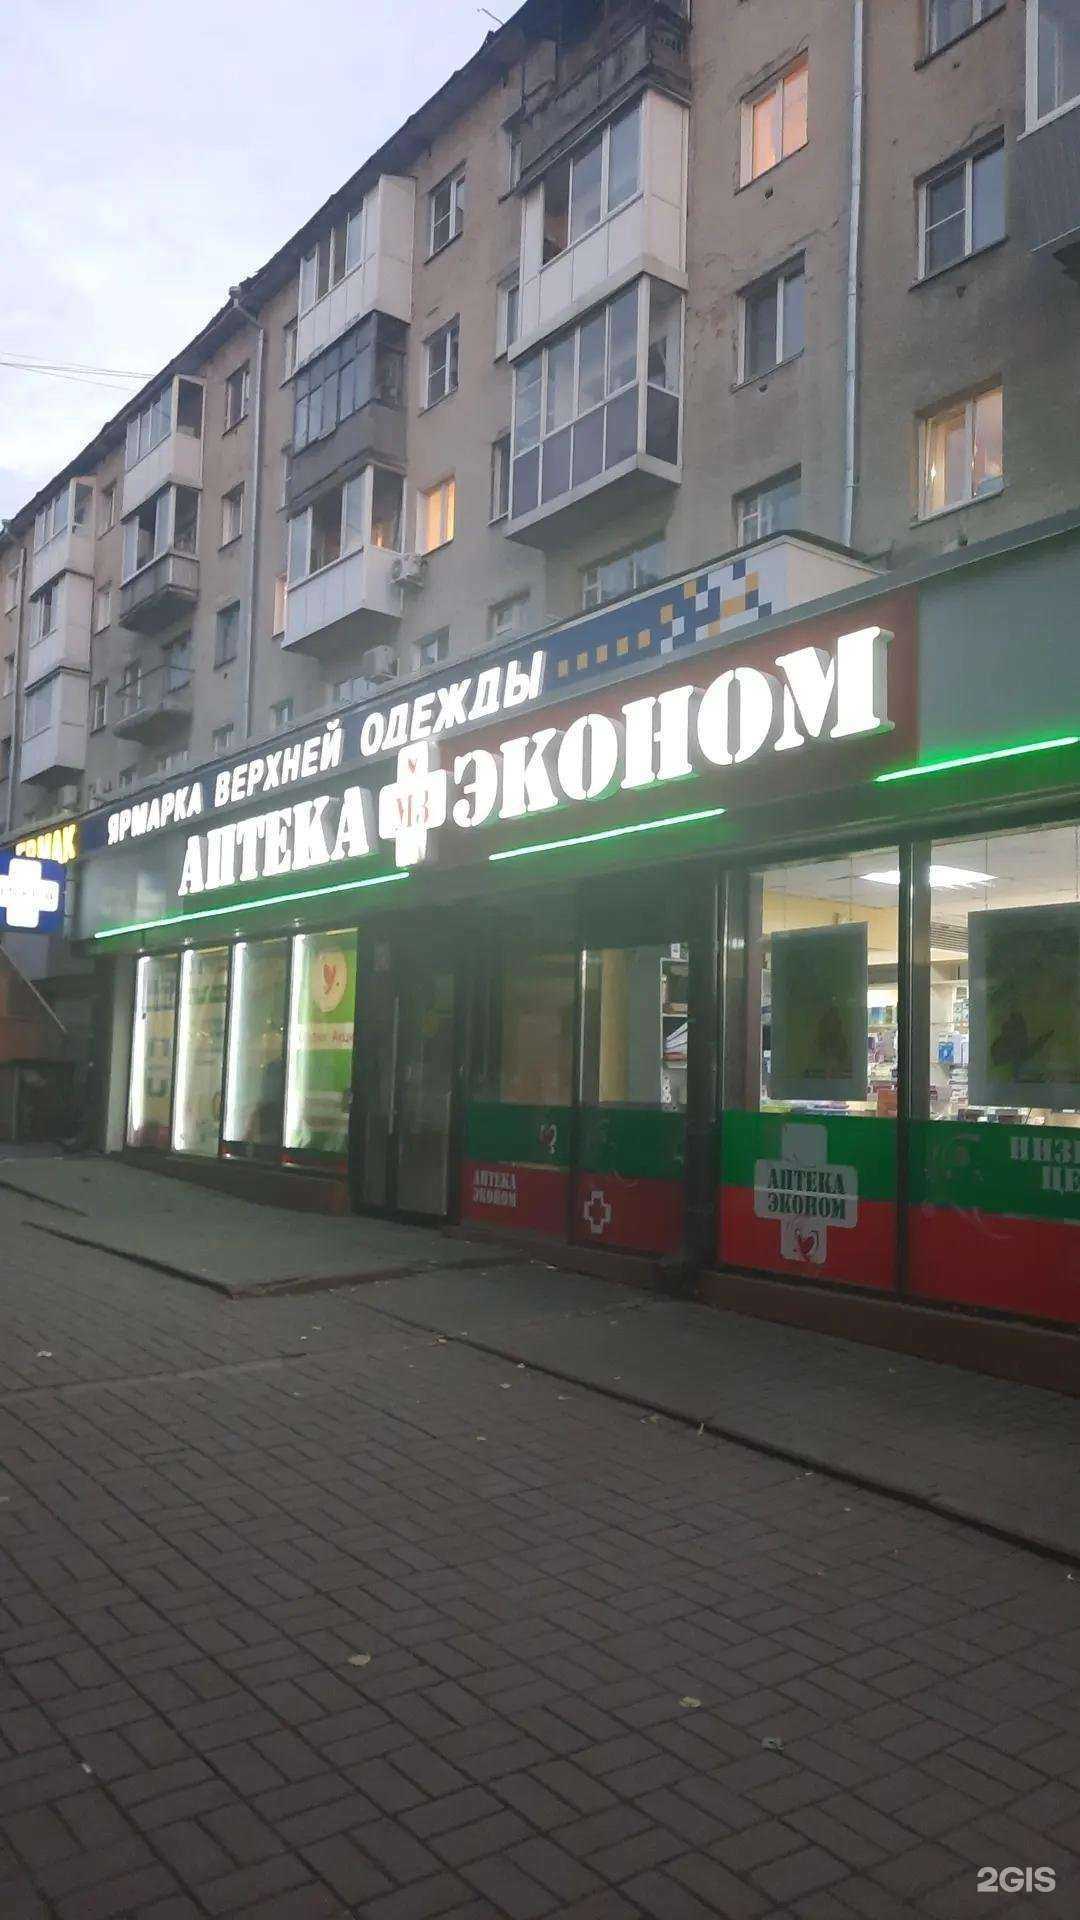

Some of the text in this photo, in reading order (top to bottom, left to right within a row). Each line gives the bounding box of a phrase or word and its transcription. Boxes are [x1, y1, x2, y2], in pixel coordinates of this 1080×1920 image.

[106, 782, 204, 846] ЯРМАРКА
[213, 719, 343, 809] ВЕРХНЕЙ
[360, 650, 547, 757] ОДЕЖДЫ
[178, 626, 886, 897] АПТЕКА ЭКОНОМ
[767, 1191, 846, 1220] ЭКОНОМ
[768, 1168, 847, 1195] АПТЕКА
